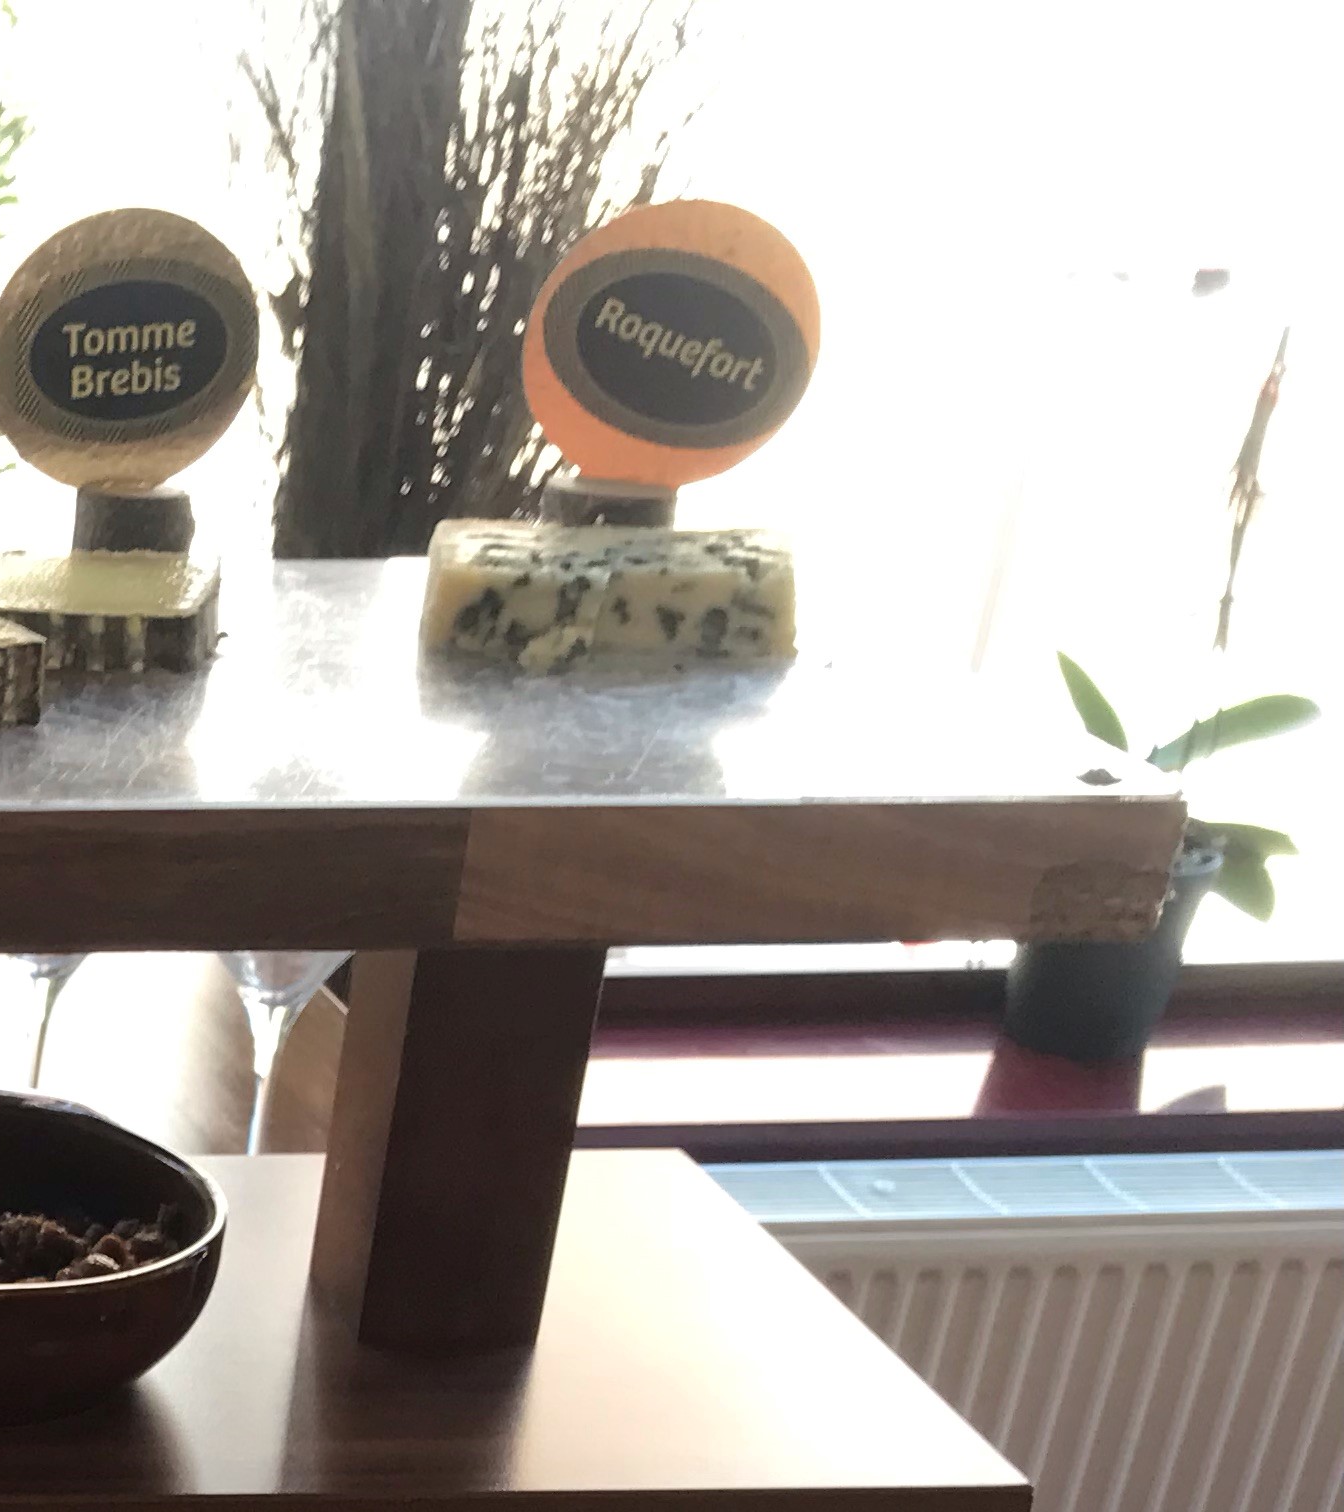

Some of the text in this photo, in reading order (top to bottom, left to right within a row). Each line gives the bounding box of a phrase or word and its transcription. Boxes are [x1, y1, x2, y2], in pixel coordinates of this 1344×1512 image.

[63, 318, 196, 356] Tomme
[594, 297, 765, 391] Roquefort
[71, 358, 181, 399] Brebis
